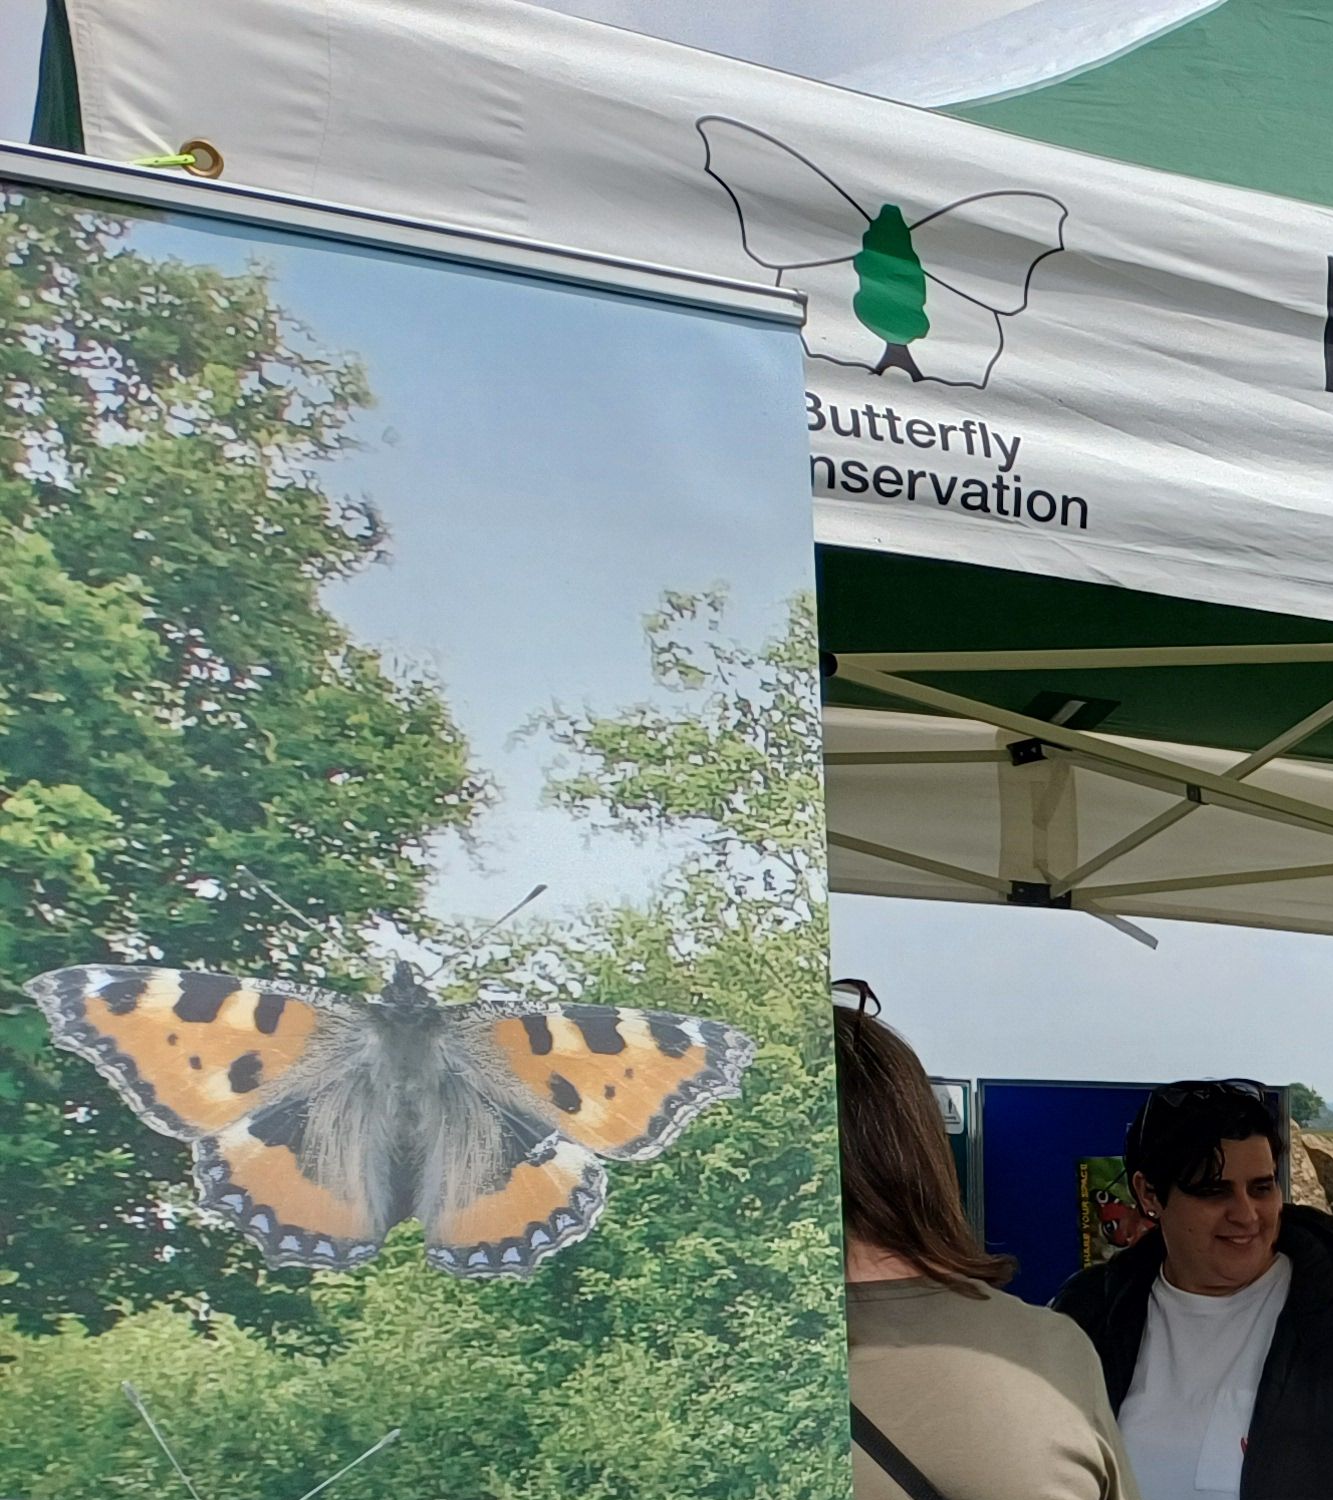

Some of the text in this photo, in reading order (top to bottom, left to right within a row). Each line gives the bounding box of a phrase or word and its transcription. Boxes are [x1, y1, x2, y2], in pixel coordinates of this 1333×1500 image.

[805, 391, 1021, 472] Butterfly
[810, 453, 1089, 530] nservation
[1081, 1201, 1089, 1229] YOUR
